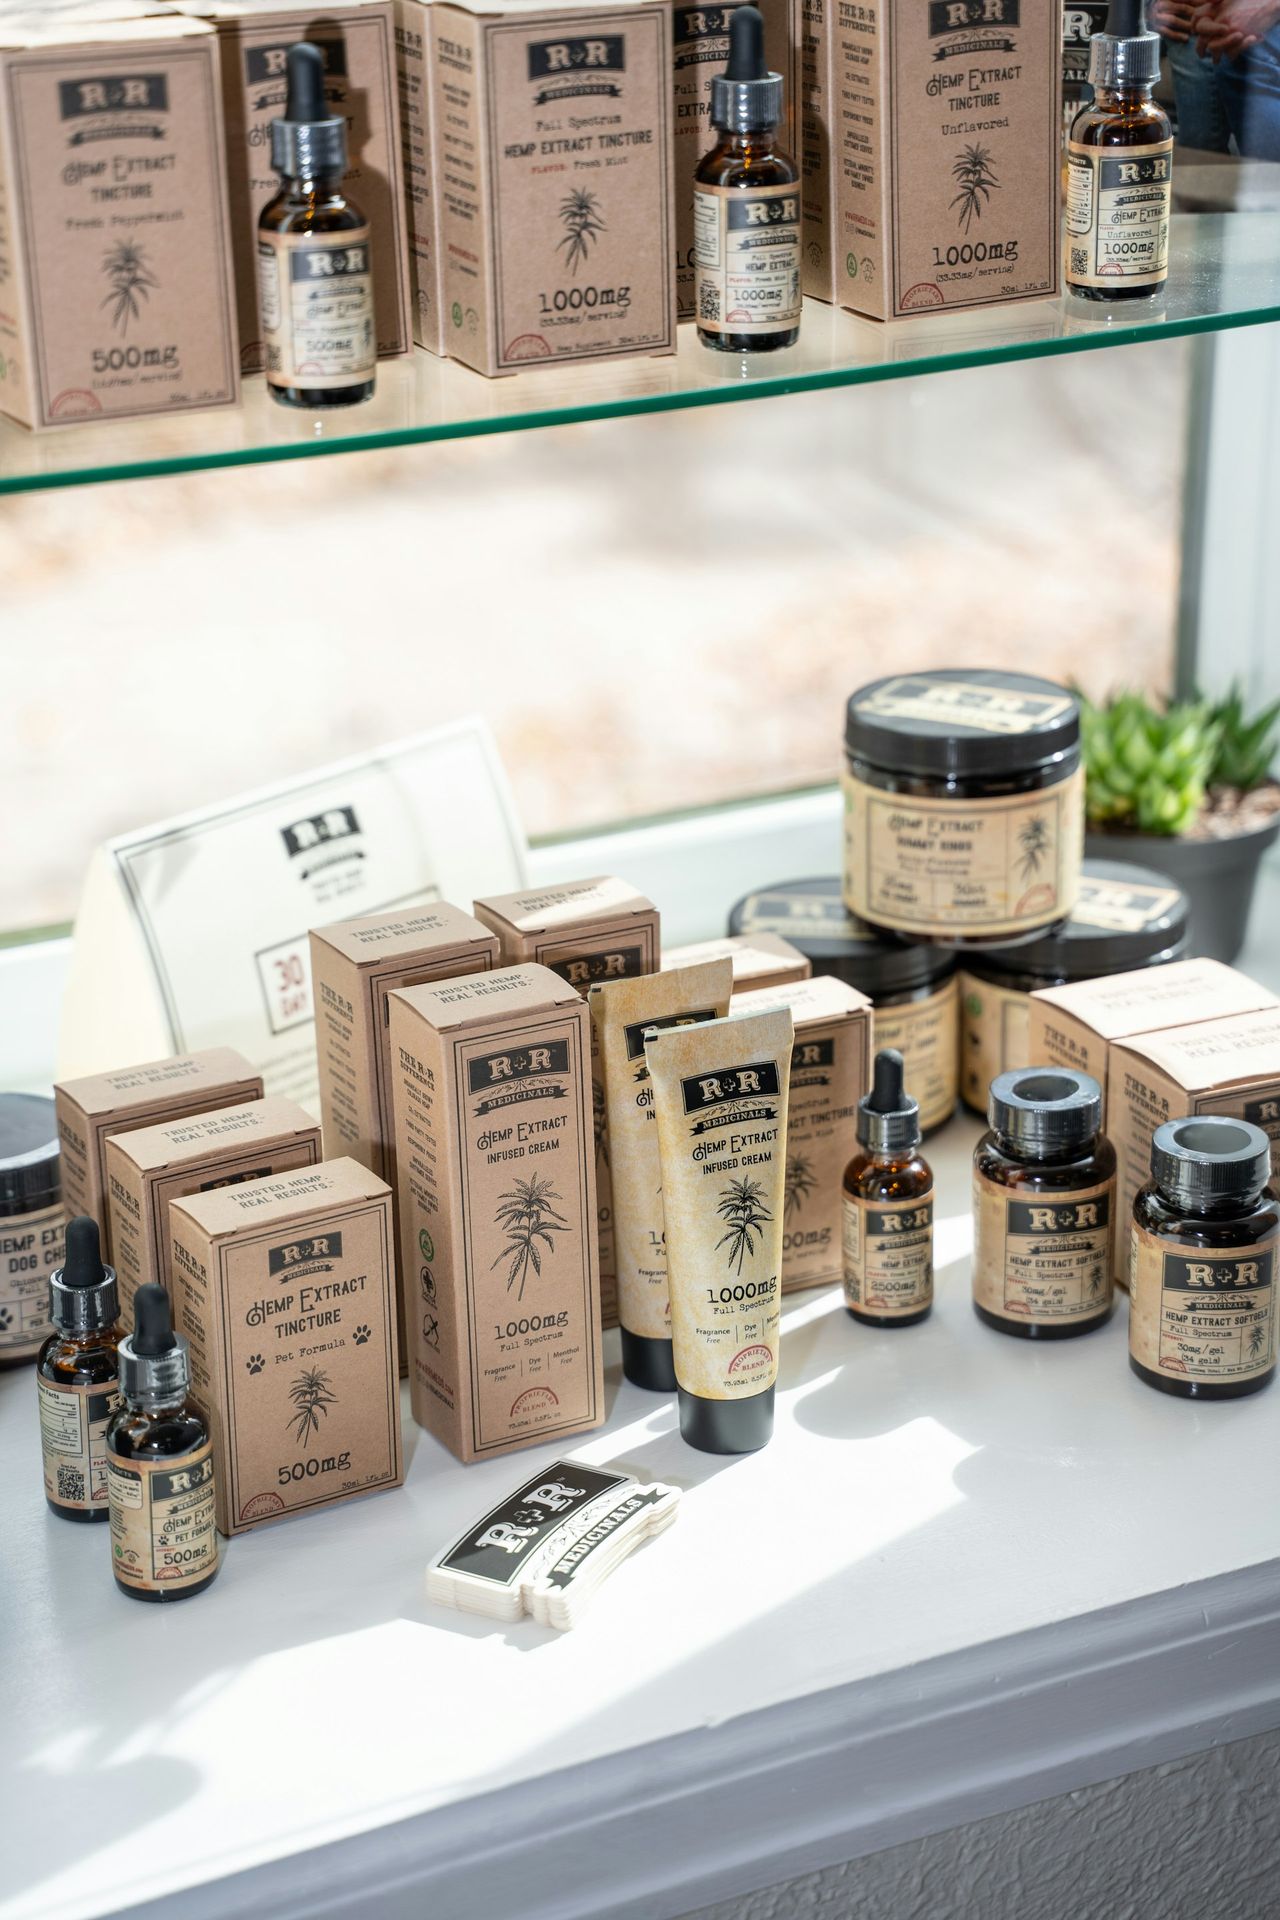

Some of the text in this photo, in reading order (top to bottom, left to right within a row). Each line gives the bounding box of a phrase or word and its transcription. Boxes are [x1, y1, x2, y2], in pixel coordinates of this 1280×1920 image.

[839, 17, 876, 35] DIFFERENCE
[944, 40, 1005, 55] MEDICINALS
[926, 65, 1022, 97] HEMP EXTRACT
[948, 93, 1000, 112] TINCTURE
[568, 115, 622, 130] Spectrum
[941, 117, 1009, 136] Unflavored
[505, 130, 652, 158] HEMP EXTRACT TINCTURE
[90, 182, 153, 202] TINCTURE
[1111, 206, 1167, 224] HEMP EXTRACT
[1107, 228, 1152, 238] Unflavored
[933, 240, 1018, 266] 1000mg
[1104, 242, 1154, 255] 1000mg
[745, 262, 766, 273] HEMP
[936, 263, 1015, 283] (33.33mg/serving)
[539, 286, 631, 313] 1000mg
[734, 289, 783, 301] 1000mg
[92, 345, 180, 373] 500mg
[514, 893, 566, 907] TRUSTED
[524, 902, 551, 912] REAL
[352, 923, 402, 939] TRUSTED
[360, 933, 392, 944] REAL
[431, 982, 487, 998] TRUSTED
[440, 994, 473, 1004] REAL
[399, 1047, 416, 1067] THE
[106, 1069, 160, 1085] TRUSTED
[400, 1060, 435, 1092] DIFFERENCE
[1124, 1072, 1147, 1096] THE
[114, 1080, 147, 1091] REAL
[487, 1087, 555, 1109] MEDICINALS
[702, 1109, 767, 1129] MEDICINALS
[811, 1105, 854, 1125] TINCTURE
[161, 1121, 218, 1138] TRUSTED
[172, 1132, 205, 1144] REAL
[477, 1115, 568, 1150] HEMP EXTRACT
[488, 1139, 560, 1164] INFUSED CREAM
[692, 1128, 778, 1161] HEMP EXTRACT
[703, 1152, 772, 1175] INFUSED CREAM
[228, 1184, 285, 1201] TRUSTED
[239, 1196, 272, 1209] REAL
[173, 1239, 190, 1261] THE
[9, 1254, 38, 1273] DOG
[174, 1252, 208, 1289] DIFFERENCE
[881, 1261, 900, 1269] HEMP
[1010, 1256, 1032, 1266] HEMP
[1035, 1259, 1073, 1268] EXTRACT
[287, 1265, 327, 1280] MEDICINALS
[1036, 1272, 1074, 1280] Spectrum
[707, 1275, 777, 1303] 1000mg
[871, 1281, 917, 1291] 2500mg
[246, 1276, 367, 1327] HEMP EXTRACT
[713, 1295, 774, 1315] Full Spectrum
[1195, 1302, 1248, 1310] MEDICINALS
[275, 1308, 341, 1339] TINCTURE
[494, 1311, 569, 1340] 1000mg
[1166, 1308, 1268, 1327] HEMP EXTRACT SOFTGELS
[696, 1327, 731, 1336] Fragrance
[744, 1323, 757, 1332] Dye
[1169, 1325, 1233, 1337] Full Spectrum
[500, 1331, 563, 1352] Full Spectrum
[275, 1337, 346, 1365] Pet Formula
[553, 1347, 579, 1359] Menthol
[529, 1357, 541, 1366] Dye
[560, 1357, 572, 1365] Free
[732, 1348, 771, 1373] PROPRIETARY
[741, 1360, 765, 1371] BLEND
[484, 1363, 516, 1376] Fragrance
[278, 1452, 351, 1485] 500mg
[342, 1479, 360, 1489] 30ml
[252, 1507, 274, 1517] BLEND
[163, 1516, 192, 1533] HEMP
[175, 1533, 189, 1543] PET
[553, 1498, 644, 1575] MEDICINALS
[164, 1545, 207, 1565] 500mg
